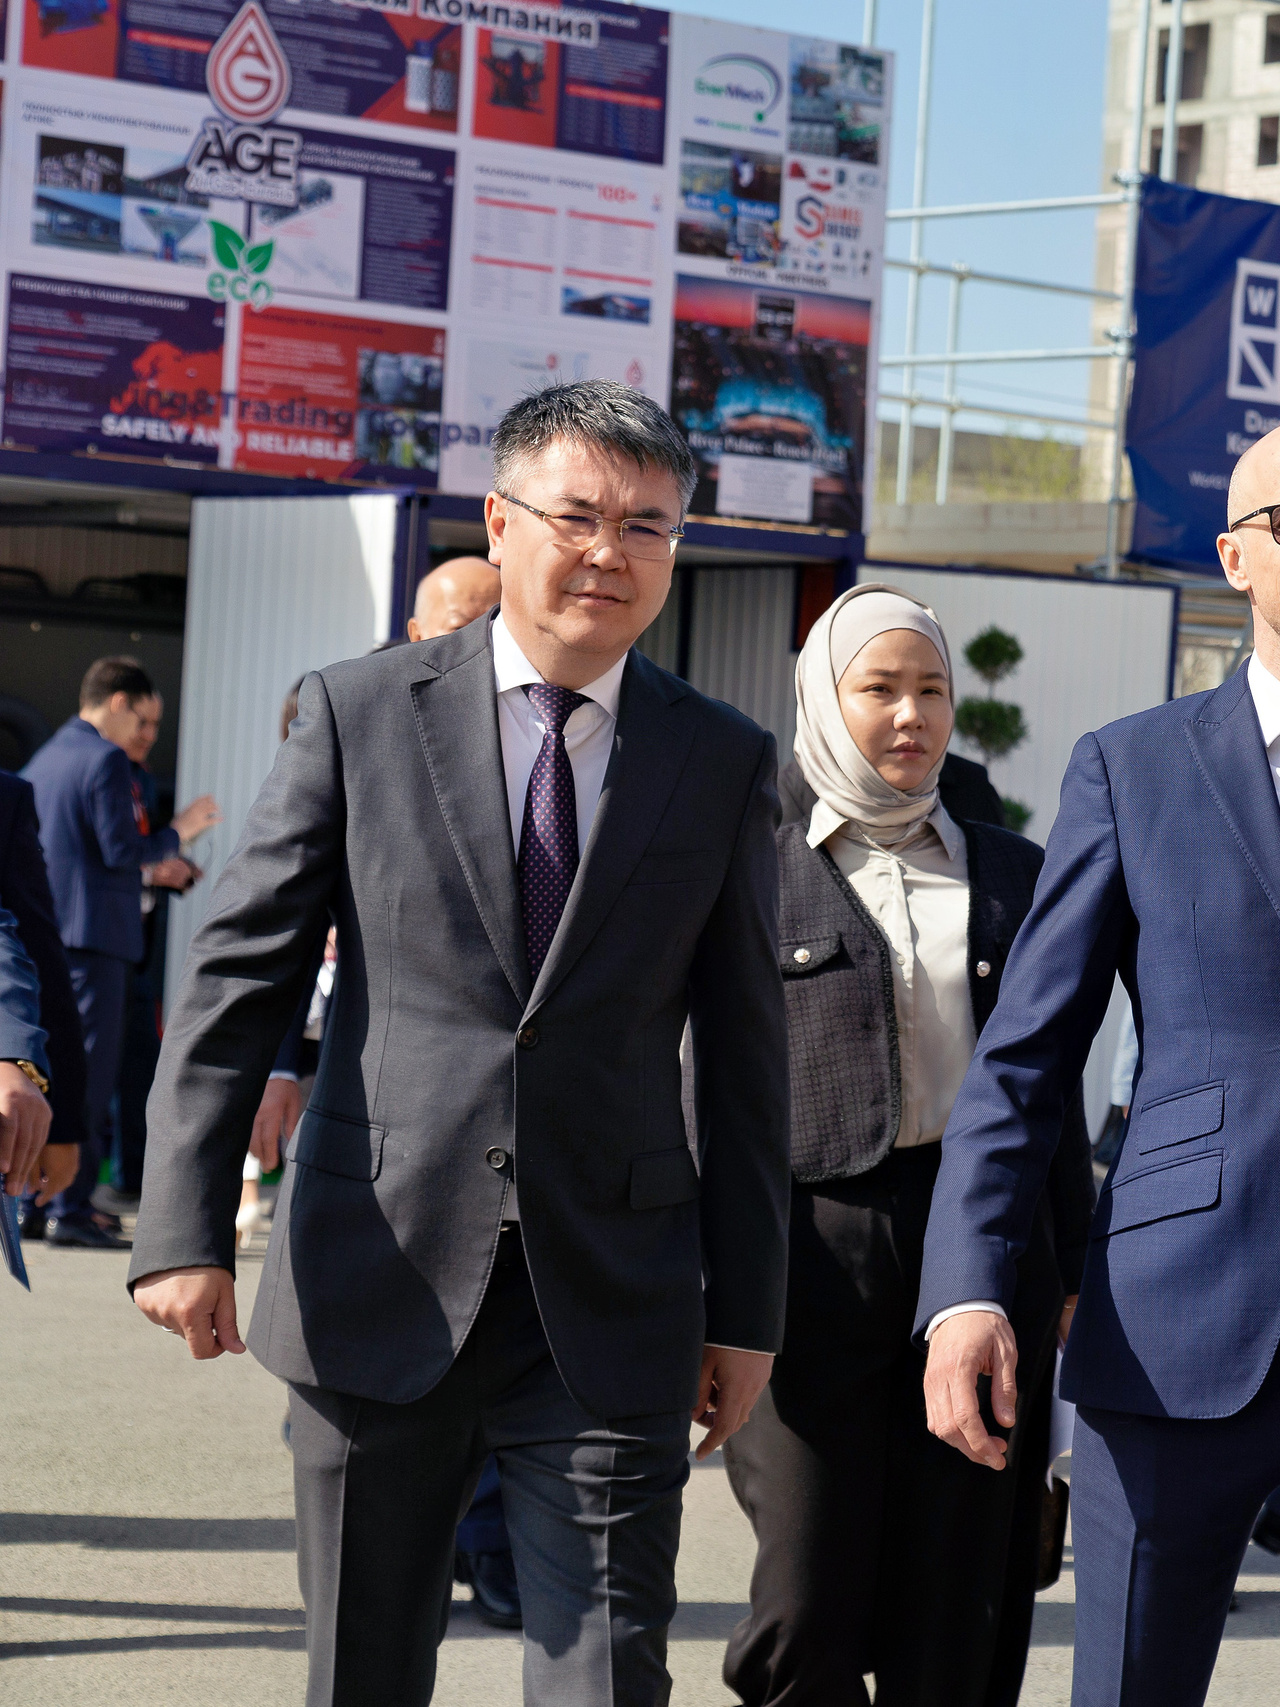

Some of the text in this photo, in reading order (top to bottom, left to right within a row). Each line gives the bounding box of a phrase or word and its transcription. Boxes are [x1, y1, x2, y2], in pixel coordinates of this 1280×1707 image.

[196, 128, 295, 180] AGE
[101, 413, 189, 445] SAFELY
[245, 431, 354, 462] RELIABLE
